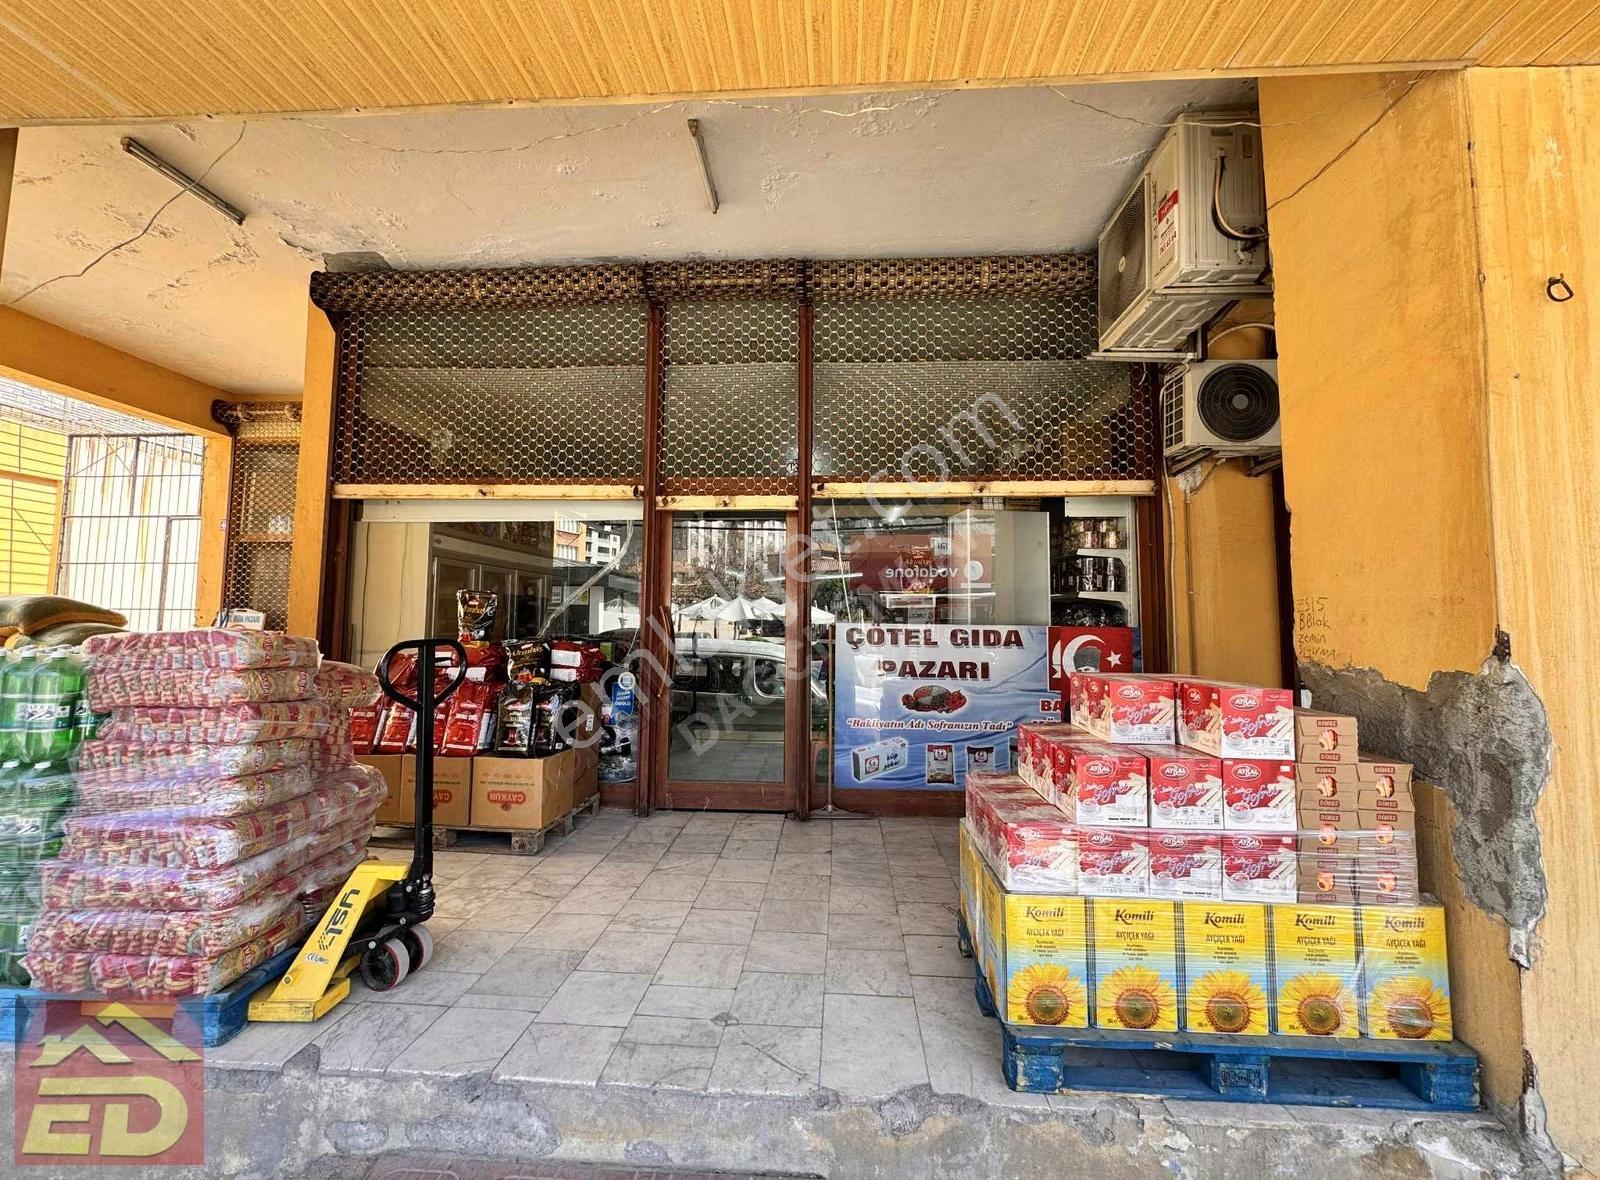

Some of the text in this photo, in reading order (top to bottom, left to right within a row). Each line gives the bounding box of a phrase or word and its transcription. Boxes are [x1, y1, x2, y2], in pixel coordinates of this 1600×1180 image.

[950, 628, 1024, 649] GIDA
[877, 660, 990, 679] PAZARI
[907, 719, 924, 729] Adı
[927, 720, 979, 731] Sofranızın
[1025, 906, 1064, 922] Komili
[1114, 909, 1155, 925] Komili
[1204, 911, 1246, 928] Komili
[1295, 913, 1336, 930] Komili
[1384, 916, 1425, 932] Komili
